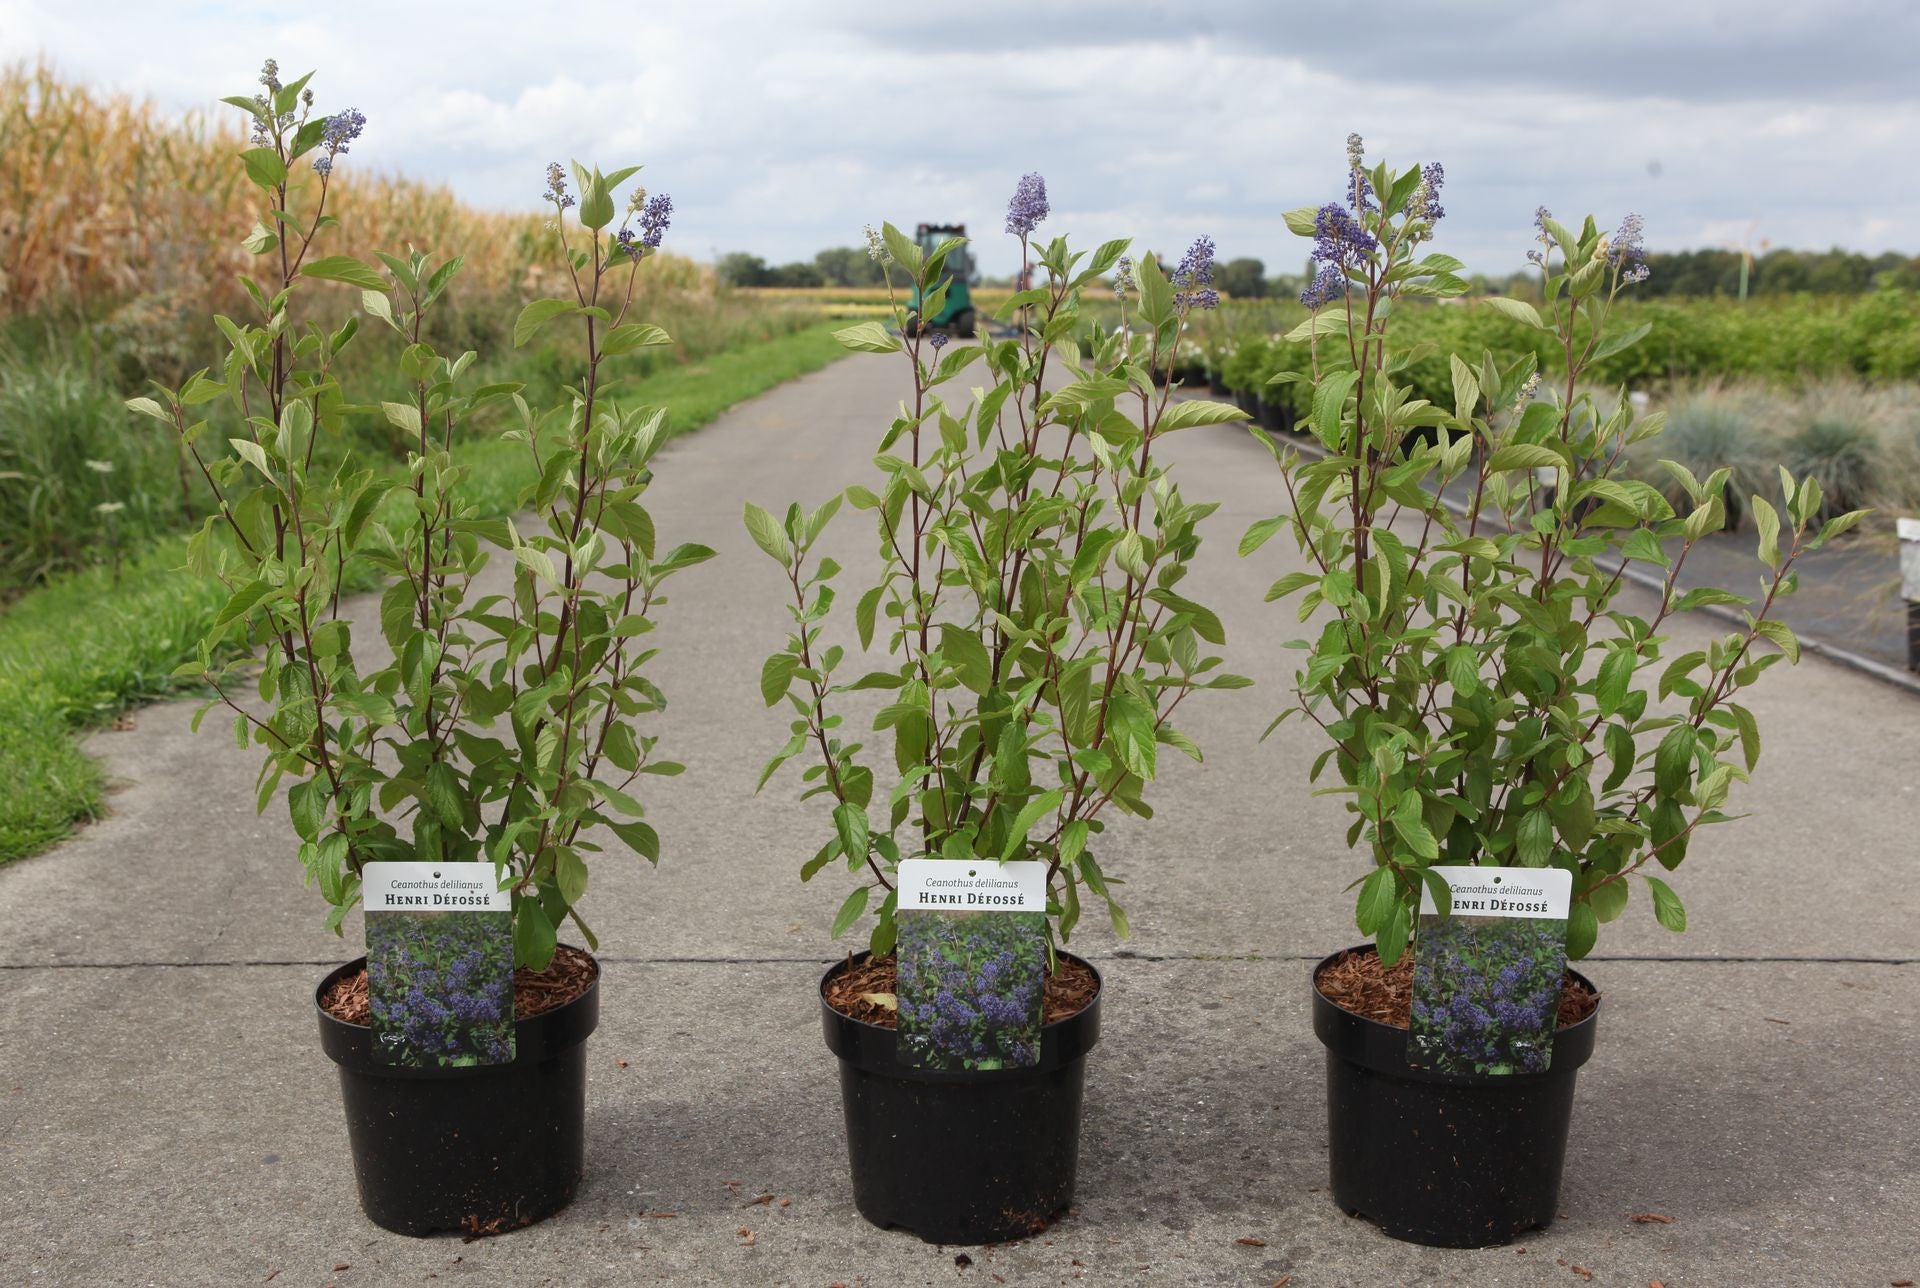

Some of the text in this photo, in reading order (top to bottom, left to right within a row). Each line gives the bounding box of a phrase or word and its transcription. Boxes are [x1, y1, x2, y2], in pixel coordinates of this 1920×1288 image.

[391, 879, 484, 890] Ceanothus delilianus
[925, 877, 1019, 889] Ceanothus delilianus
[1450, 884, 1543, 896] Ceanothus delilianus
[385, 893, 490, 905] HENRI DÉFOSSÉ
[919, 892, 1025, 905] HENRI DÉFOSSÉ
[1453, 899, 1548, 912] ENRI DÉFOSSÉ
